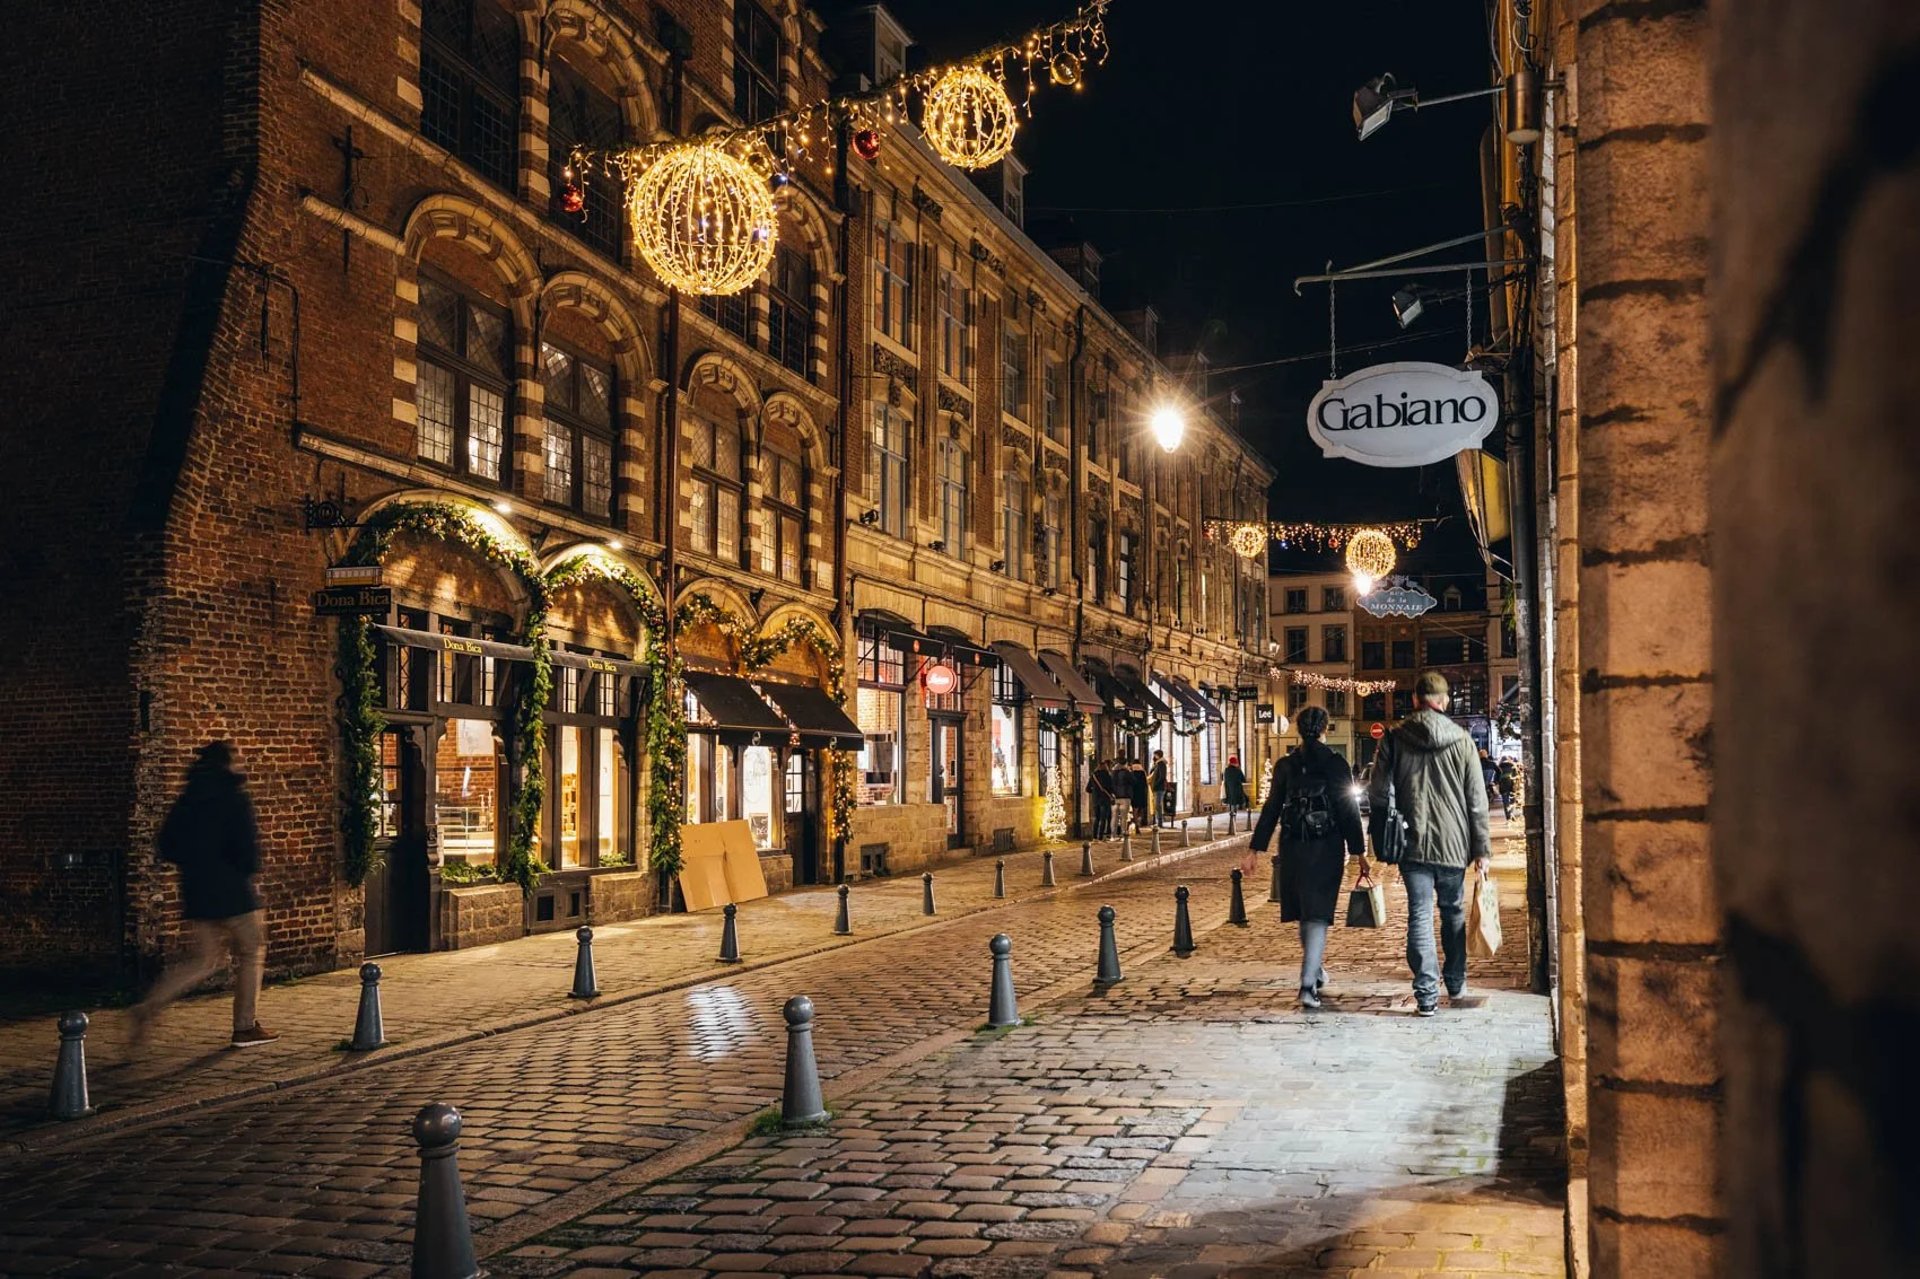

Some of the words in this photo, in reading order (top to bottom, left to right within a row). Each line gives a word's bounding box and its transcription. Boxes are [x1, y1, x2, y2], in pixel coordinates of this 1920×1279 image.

[1318, 392, 1487, 431] Gabiano
[317, 593, 354, 606] Dona
[359, 591, 389, 605] Bica
[1371, 603, 1423, 611] MONNAIE
[444, 638, 464, 651] Dona
[466, 641, 482, 653] Bica
